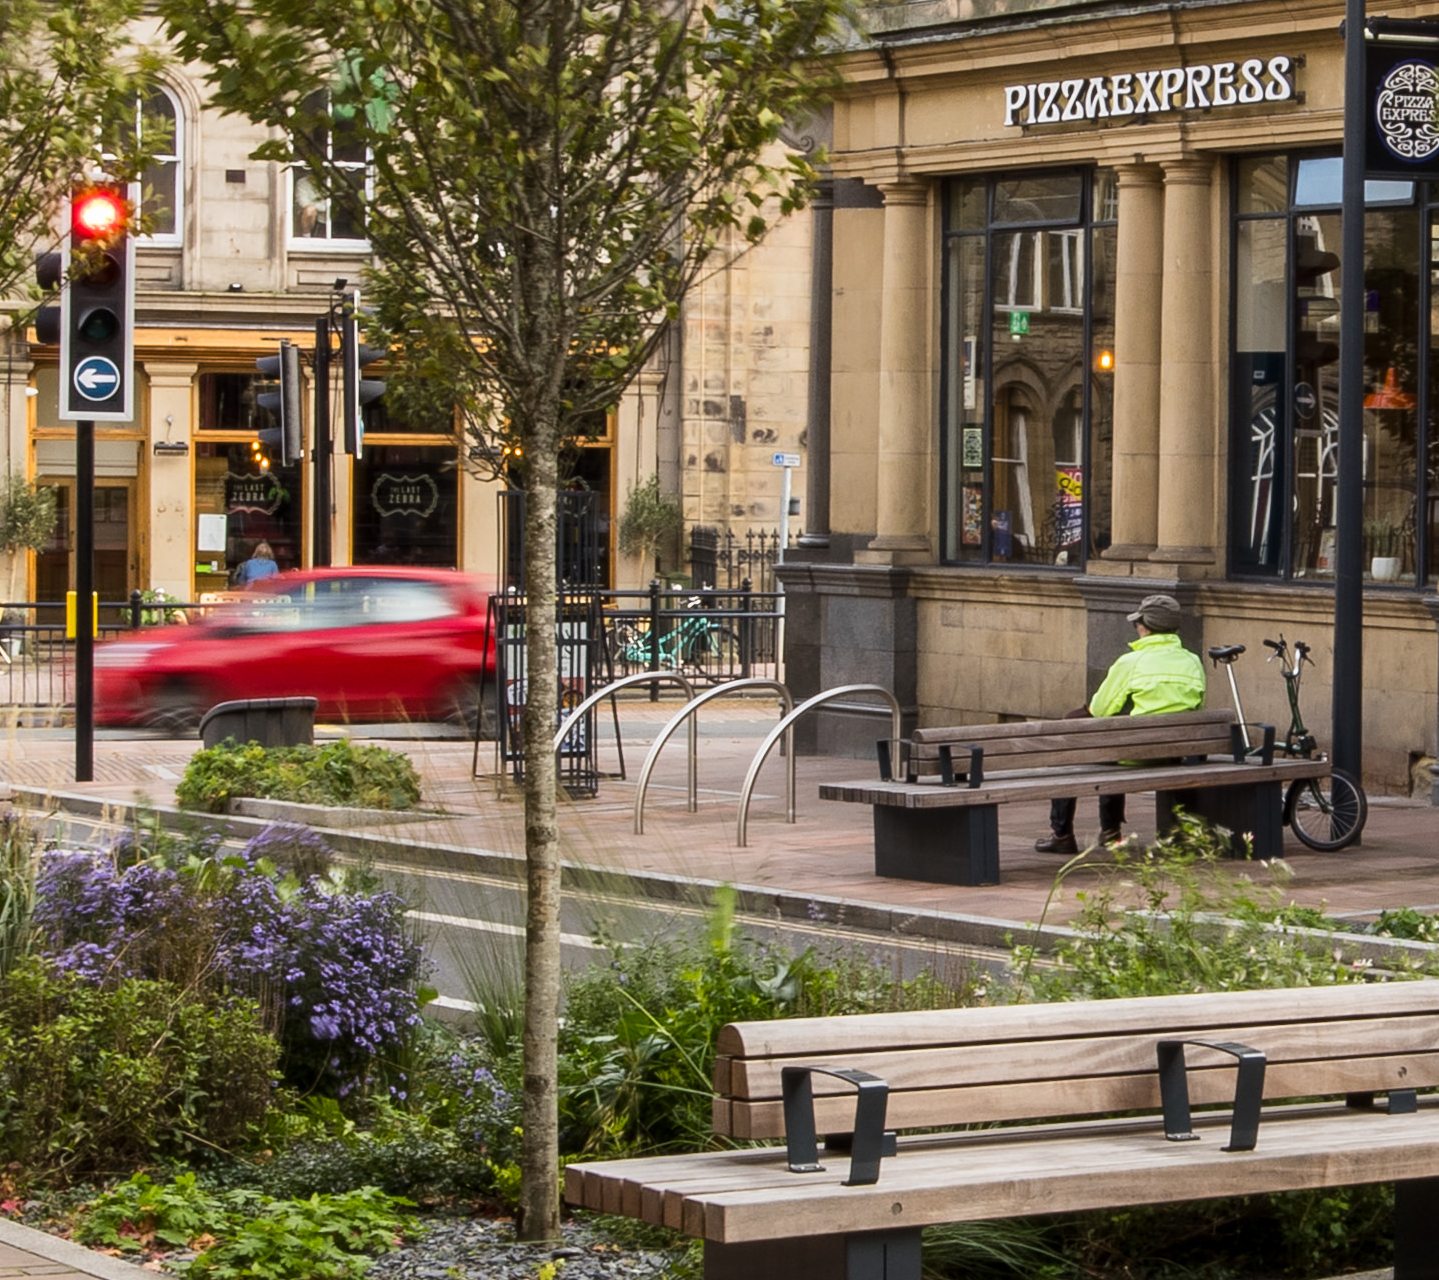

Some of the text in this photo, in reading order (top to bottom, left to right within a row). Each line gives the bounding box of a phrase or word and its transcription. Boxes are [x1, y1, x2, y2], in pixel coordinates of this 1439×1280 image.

[1003, 55, 1292, 126] PIZZAEXPRESS
[1394, 95, 1435, 109] PIZZA
[244, 483, 265, 491] LAST
[400, 486, 421, 494] LAST
[232, 492, 266, 502] ZEBRA
[388, 494, 422, 504] ZEBRA
